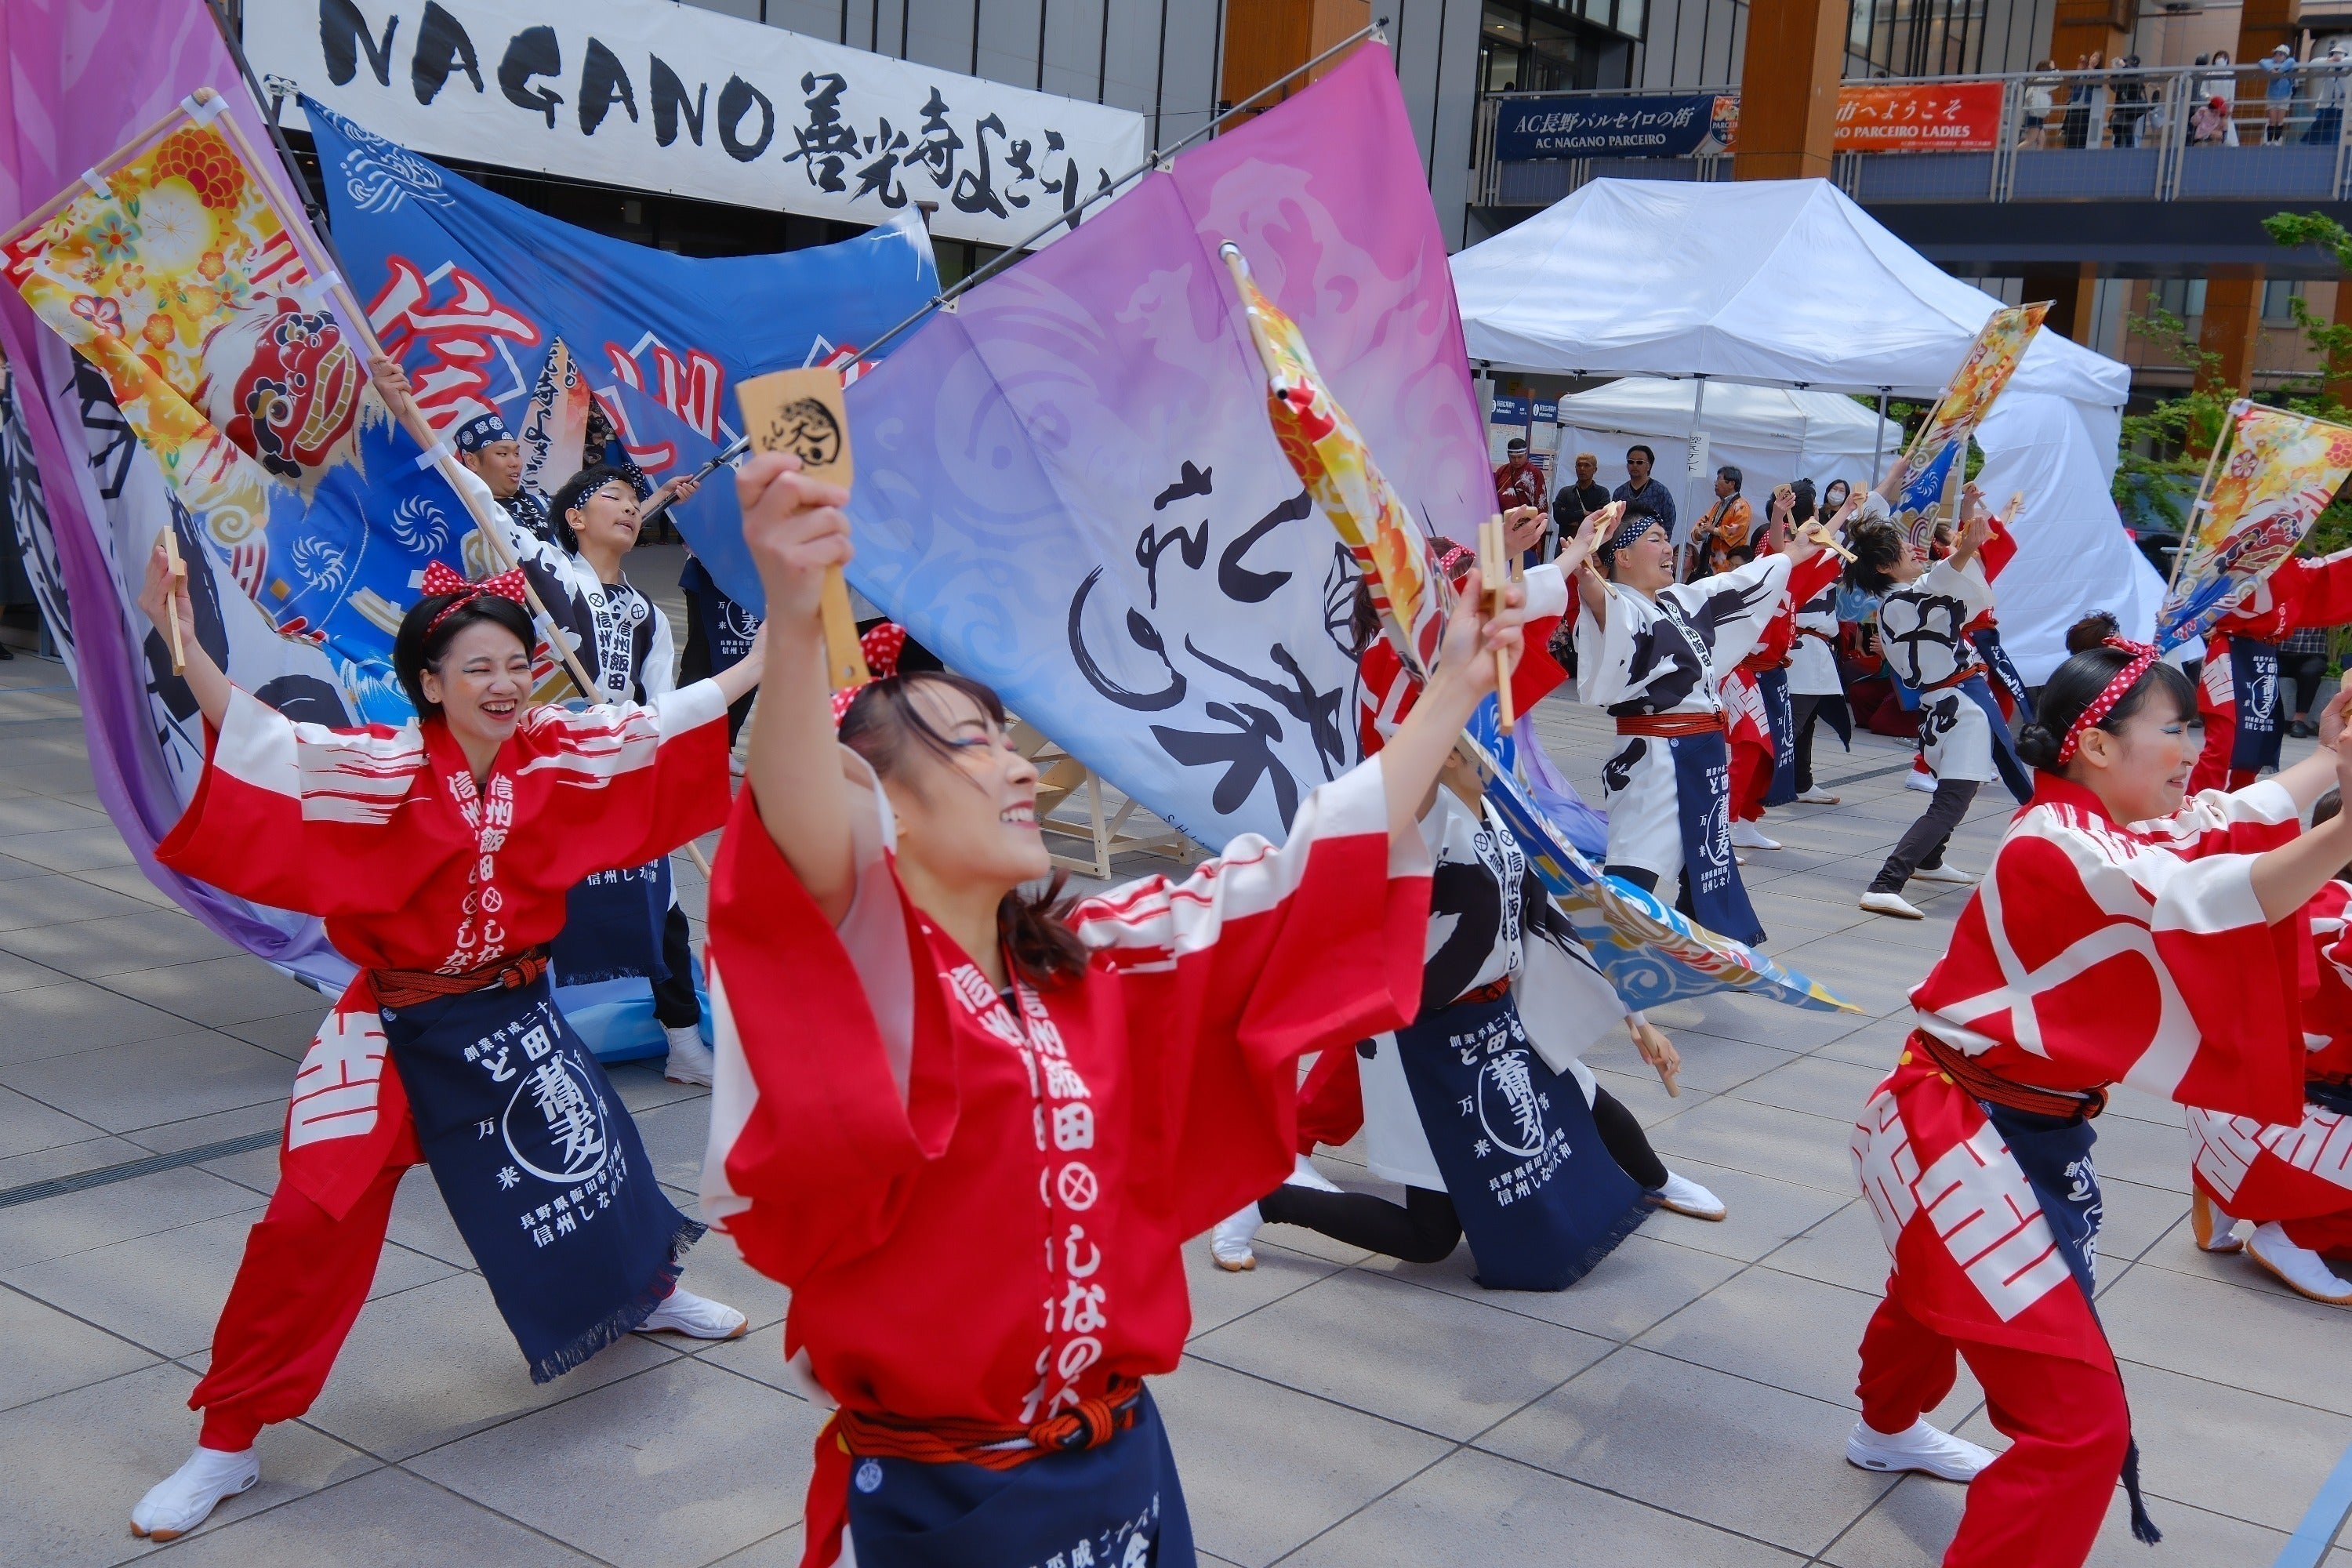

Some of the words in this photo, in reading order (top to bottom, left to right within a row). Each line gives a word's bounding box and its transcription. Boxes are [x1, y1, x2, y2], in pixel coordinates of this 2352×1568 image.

[319, 0, 775, 162] NAGANO
[782, 71, 1113, 230] 善光寺よさこい
[1513, 107, 1696, 134] AC長野パルセイロの街
[1535, 137, 1552, 149] AC
[1555, 136, 1606, 148] NAGANO
[1608, 133, 1667, 147] PARCEIRO
[1853, 125, 1919, 137] PARCEIRO
[1922, 125, 1971, 137] LADIES
[608, 618, 633, 691] 信州飯田
[479, 771, 514, 882] 信州飯田
[1497, 1141, 1573, 1207] 信州しなの大和
